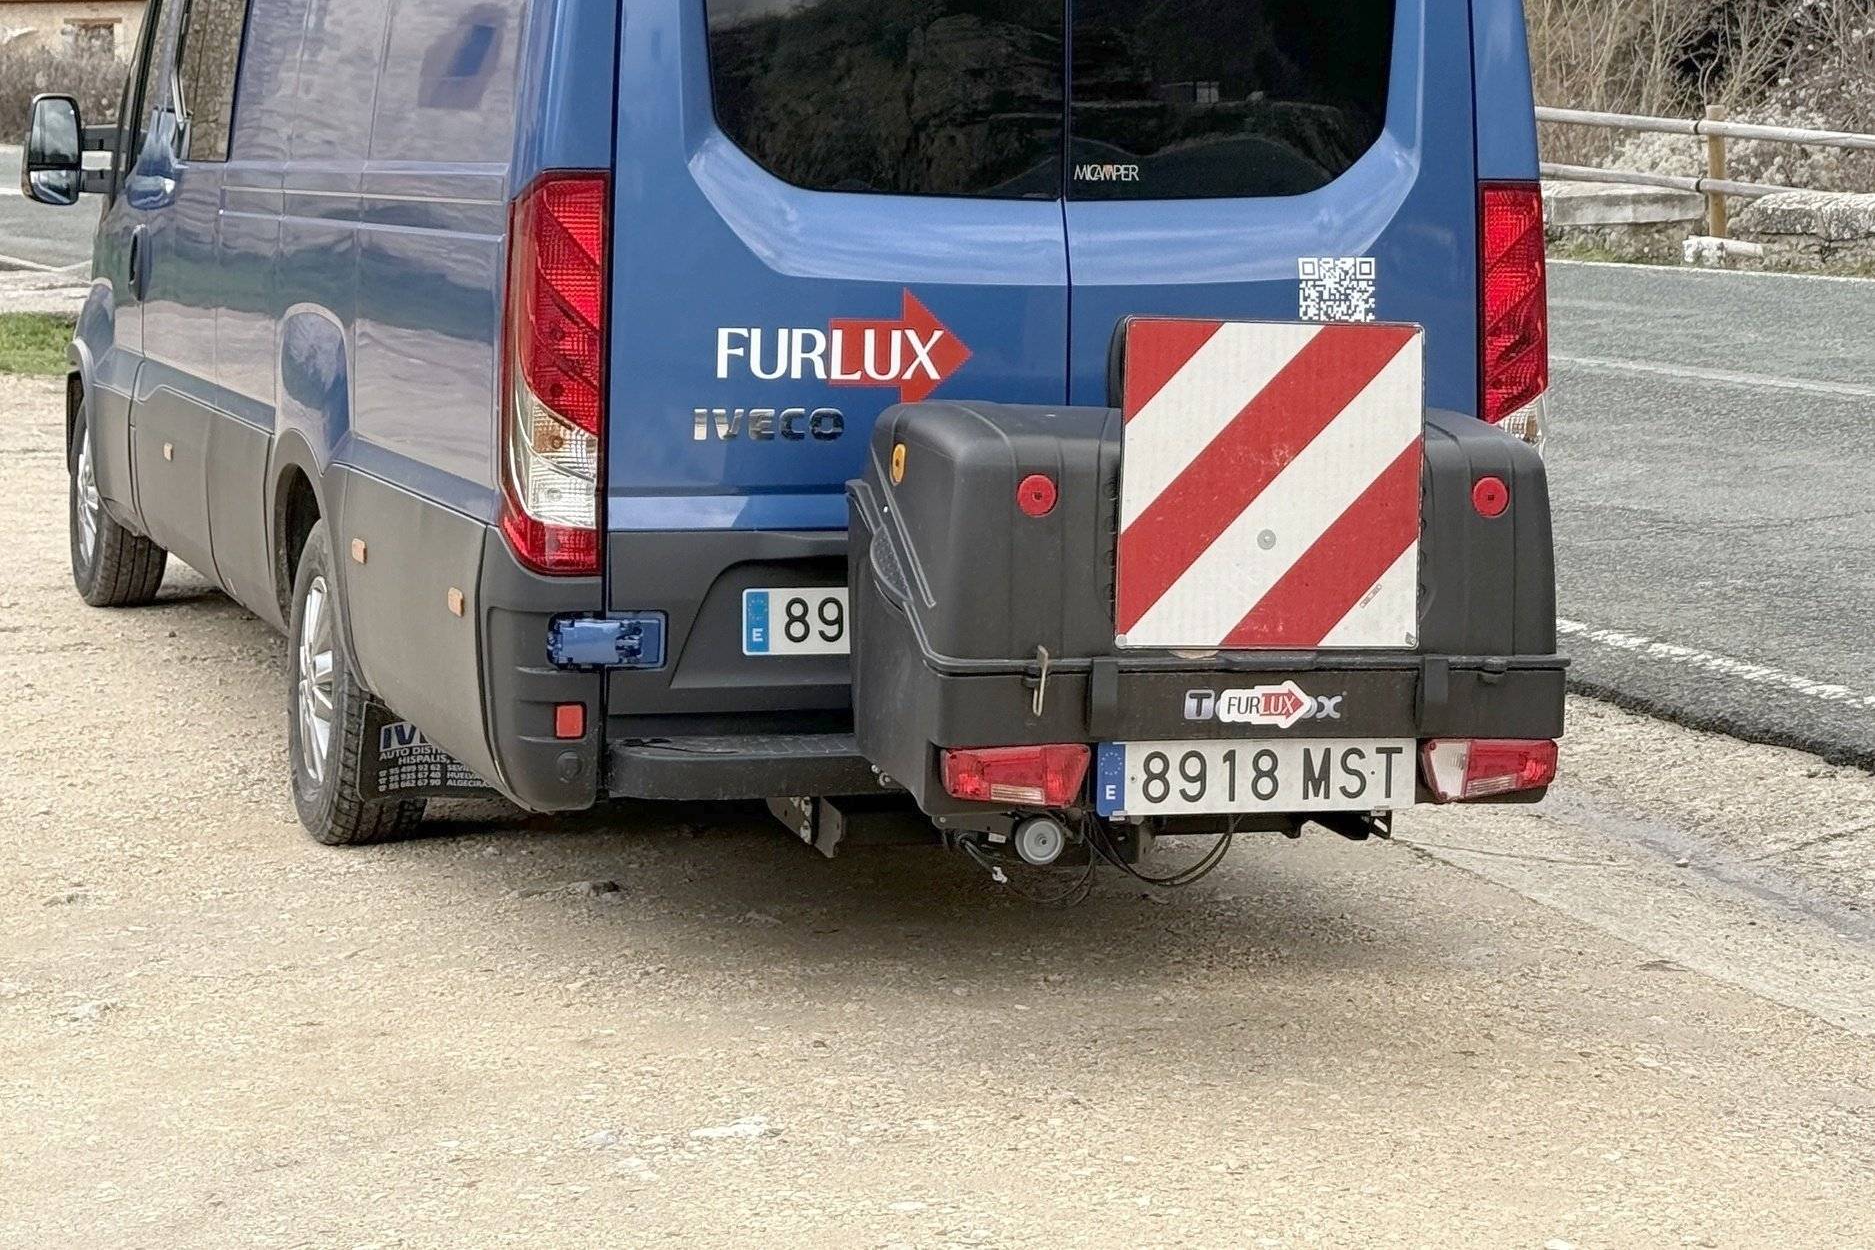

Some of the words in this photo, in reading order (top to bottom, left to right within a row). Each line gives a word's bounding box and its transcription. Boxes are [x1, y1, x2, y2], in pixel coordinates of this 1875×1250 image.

[716, 327, 944, 380] FURLUX
[693, 407, 845, 440] IVECO
[752, 628, 763, 642] E
[1227, 694, 1296, 716] FURLUX
[382, 724, 417, 750] IV
[379, 748, 410, 761] AUTO
[398, 754, 450, 766] HISPALIS,
[446, 779, 489, 787] ALGECIRA
[1105, 784, 1117, 800] E
[1142, 750, 1279, 803] 8918
[1302, 746, 1404, 801] MST
